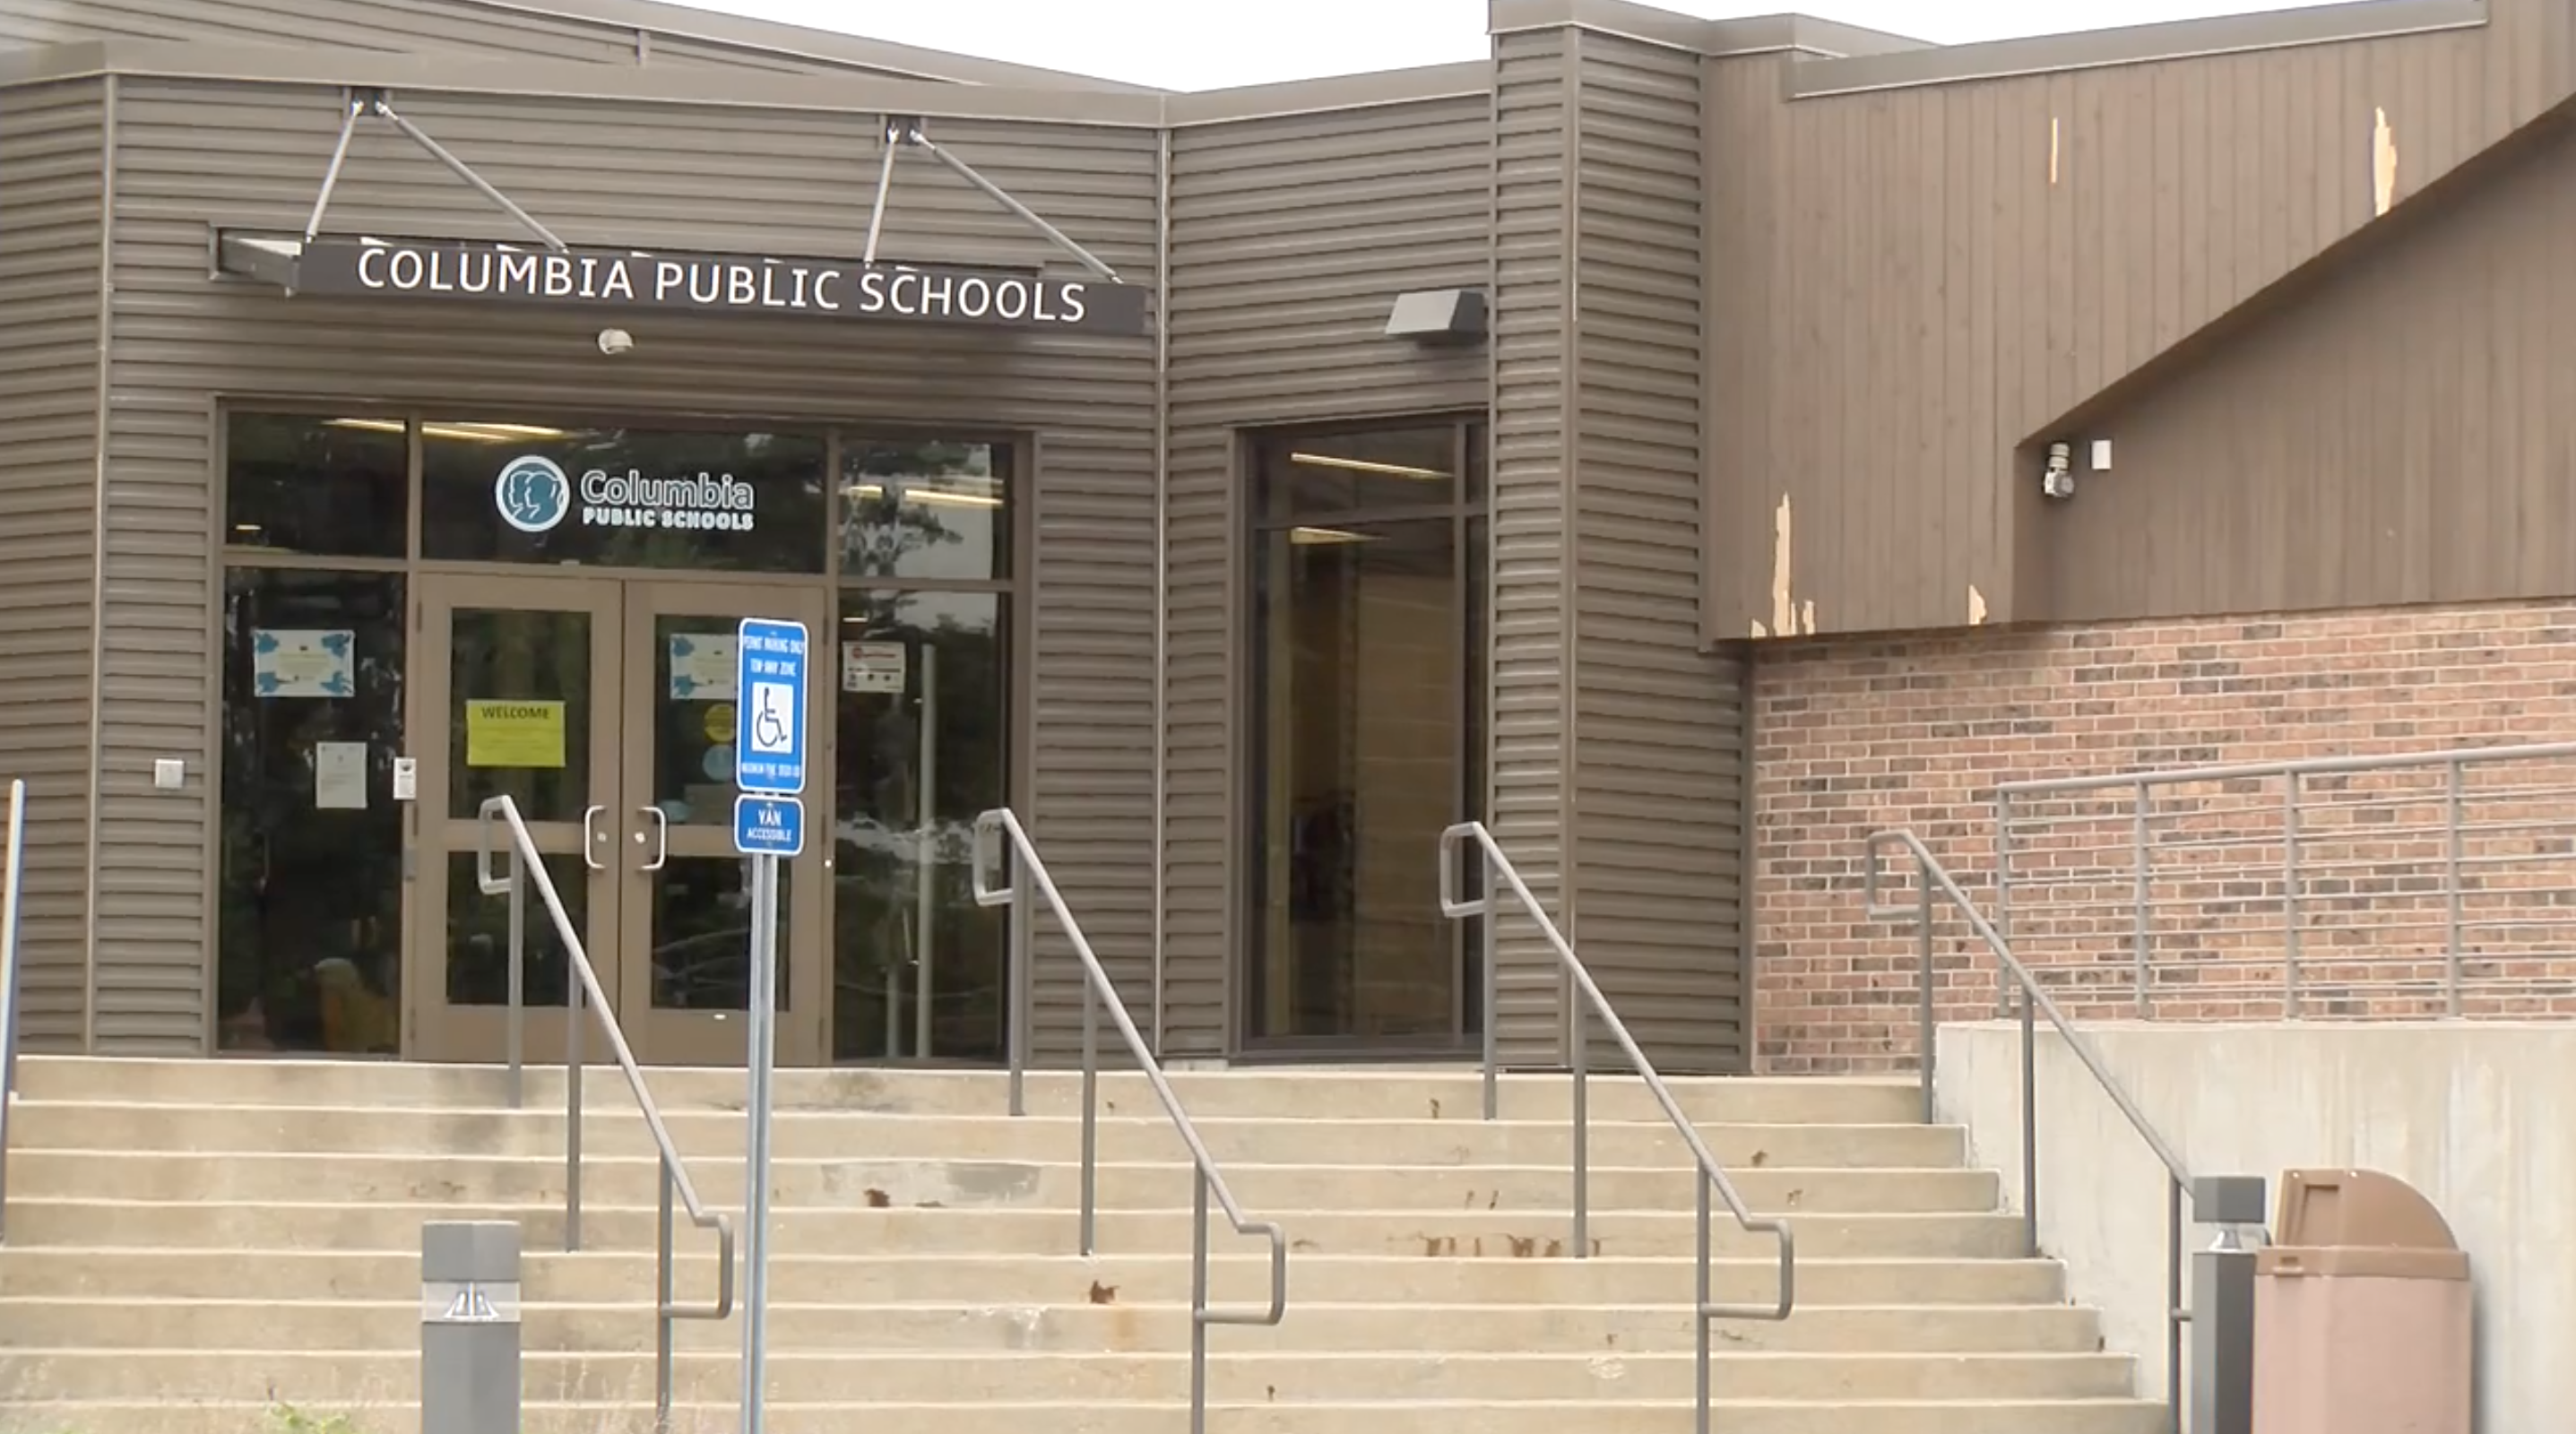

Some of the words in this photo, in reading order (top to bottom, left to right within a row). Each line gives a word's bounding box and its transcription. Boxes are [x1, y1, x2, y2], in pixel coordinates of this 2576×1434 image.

[359, 248, 634, 299] COLUMBIA
[655, 261, 840, 309] PUBLIC
[860, 272, 1085, 323] SCHOOLS
[581, 470, 754, 510] Columbia
[583, 507, 655, 527] PUBLIC
[661, 512, 754, 531] SCHOOLS
[481, 706, 549, 720] WELCOME
[758, 808, 782, 826] VAN
[747, 826, 791, 842] ACCESSIBLE
